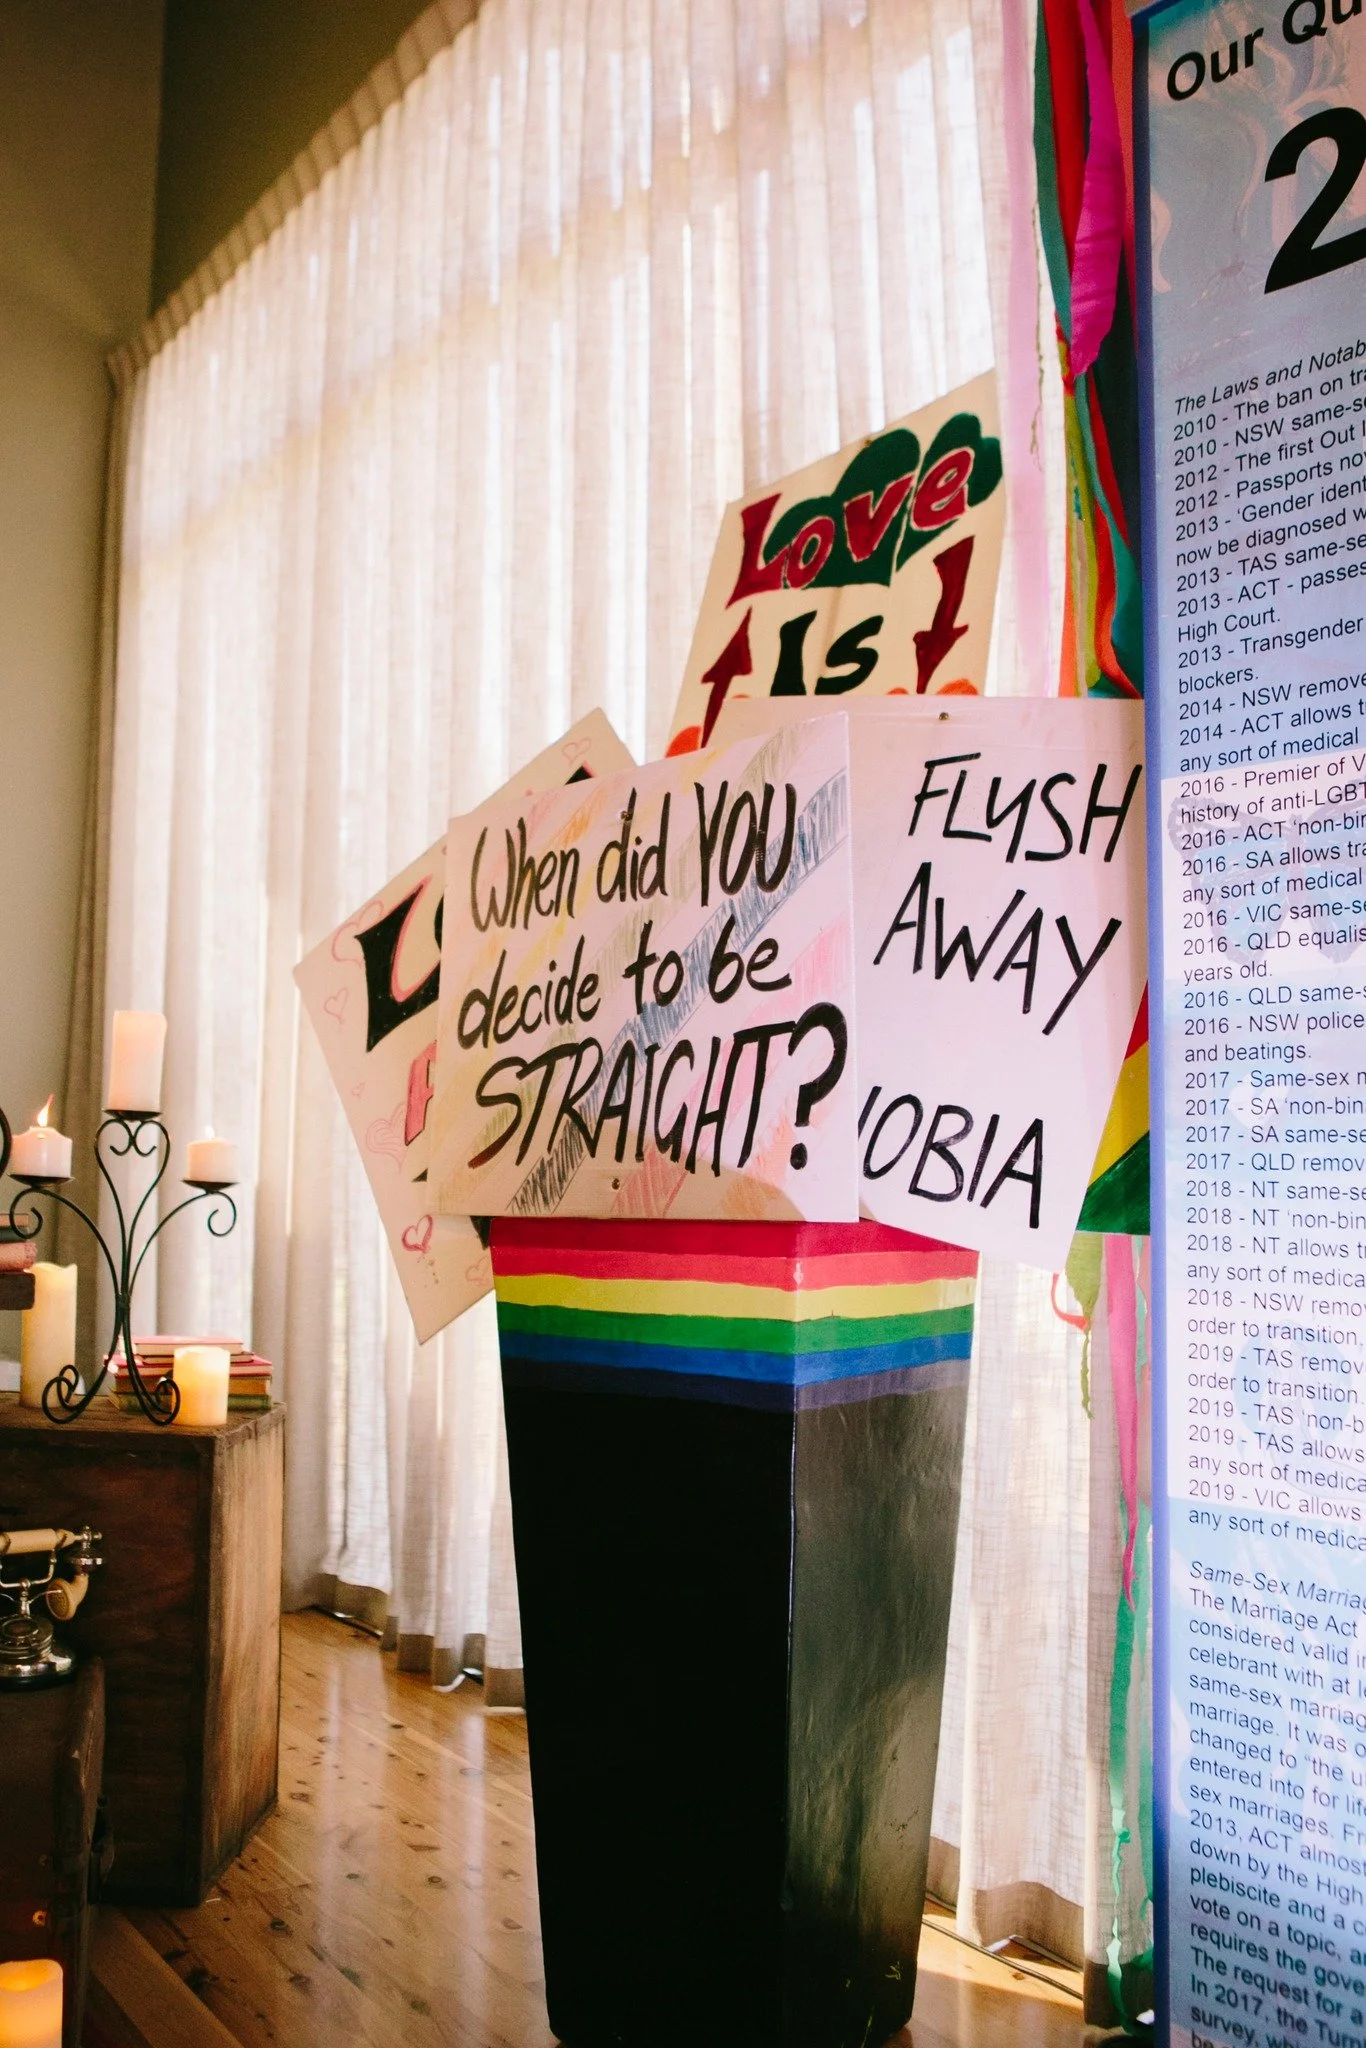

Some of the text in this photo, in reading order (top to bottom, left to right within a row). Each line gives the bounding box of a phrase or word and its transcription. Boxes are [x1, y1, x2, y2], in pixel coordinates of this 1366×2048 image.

[1167, 27, 1264, 100] Our
[1175, 396, 1205, 415] The
[1212, 376, 1258, 403] Laws
[1266, 360, 1302, 386] and
[1174, 377, 1342, 441] 2010 The ban on
[1174, 418, 1284, 466] 2010 NSW
[1175, 465, 1217, 491] 2012
[1236, 452, 1270, 471] The
[1278, 437, 1313, 461] first
[1321, 427, 1354, 448] Out
[1176, 461, 1332, 516] 2012 Passports
[1176, 516, 1218, 541] 2013
[1176, 509, 1346, 566] now be diagnosed
[1177, 553, 1276, 591] 2013 TAS
[1178, 578, 1280, 617] 2013 ACT
[1178, 607, 1280, 642] High Court.
[1178, 618, 1363, 668] 2013 Transgender
[1179, 668, 1258, 693] blockers.
[1179, 684, 1291, 719] 2014 NSW
[1180, 705, 1351, 745] 2014 ACT allows
[1180, 727, 1358, 772] any sort of medical
[1181, 757, 1345, 797] 2016 Premier of
[909, 752, 1142, 863] FLUSH
[1181, 803, 1239, 823] history
[1247, 797, 1264, 815] of
[1182, 821, 1286, 850] 2016 ACT
[471, 781, 796, 932] When did YOU
[1183, 845, 1340, 876] 2016 SA allows
[1183, 868, 1362, 904] any sort of medical
[1183, 904, 1281, 928] 2016 VIC
[874, 862, 1122, 1035] AWAY
[1184, 931, 1290, 955] 2016 QLD
[458, 935, 600, 1050] decide
[623, 920, 682, 1003] to
[709, 918, 791, 1003] be
[1184, 961, 1272, 986] years old.
[1184, 986, 1291, 1008] 2016 QLD
[1185, 1011, 1364, 1035] 2016 NSW police
[1185, 1043, 1311, 1062] and beatings.
[469, 1003, 849, 1176] STRAIGHT?
[1186, 1070, 1349, 1088] 2017 Same-sex
[1186, 1098, 1278, 1115] 2017 SA
[1186, 1125, 1279, 1142] 2017 SA
[1187, 1153, 1295, 1171] 2017 QLD
[1187, 1181, 1279, 1198] 2018 NT
[1187, 1208, 1279, 1226] 2018 NT
[1187, 1235, 1348, 1258] 2018 NT allows
[1188, 1289, 1303, 1311] 2018 NSW
[1188, 1318, 1235, 1334] order
[1243, 1321, 1259, 1337] to
[1189, 1343, 1293, 1368] 2019 TAS
[1189, 1373, 1236, 1389] order
[1244, 1376, 1260, 1393] to
[1189, 1398, 1294, 1425] 2019 TAS
[1189, 1425, 1364, 1462] 2019 TAS allows
[1189, 1455, 1289, 1481] any sort of
[1189, 1480, 1361, 1521] 2019 VIC allows
[1190, 1561, 1289, 1595] Same-Sex
[1189, 1588, 1358, 1637] The Marriage Act
[1190, 1619, 1348, 1665] considered valid
[1190, 1647, 1350, 1695] celebrant with at
[1190, 1674, 1282, 1708] same-sex
[1190, 1728, 1296, 1768] changed to
[1289, 1722, 1299, 1741] It
[1307, 1730, 1347, 1753] was
[1190, 1785, 1222, 1805] sex
[1191, 1757, 1339, 1808] entered into for
[1250, 1826, 1293, 1853] ACT
[1191, 1838, 1363, 1905] down by the High
[1191, 1867, 1324, 1923] plebiscite and
[1191, 1895, 1341, 1960] vote on topic,
[1191, 1923, 1306, 1975] requires the
[1191, 1947, 1342, 2016] The request for
